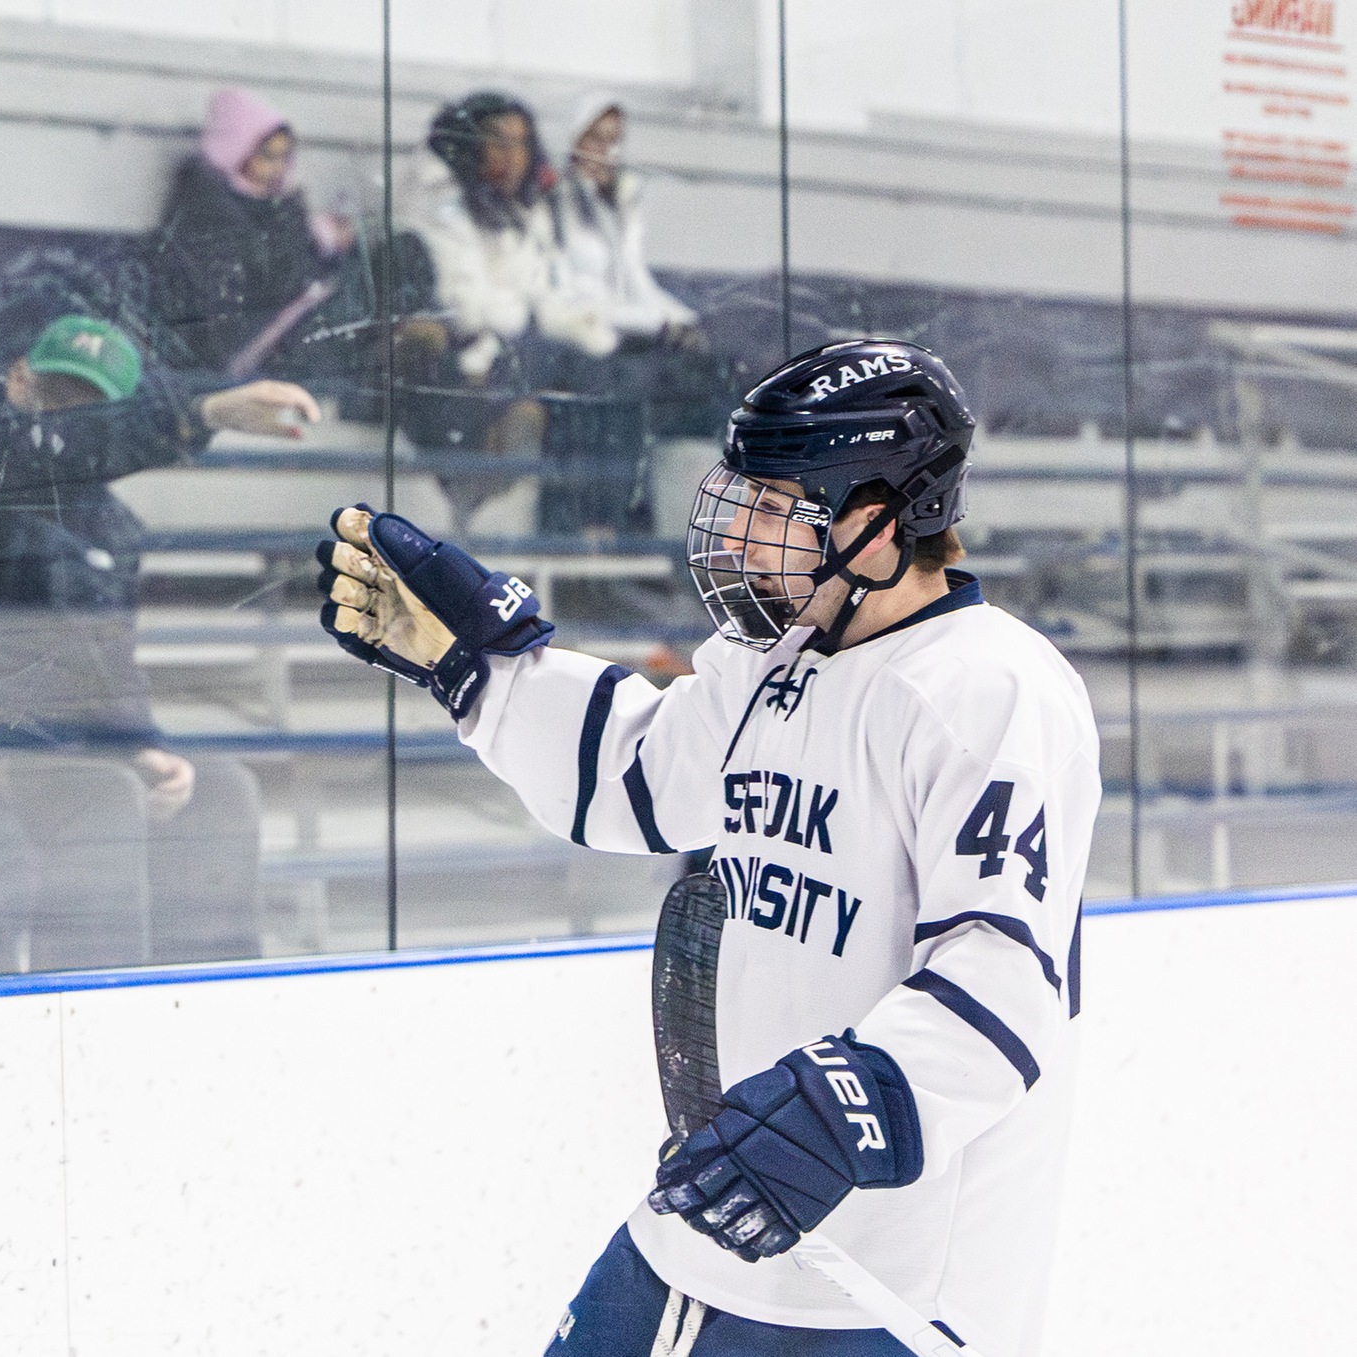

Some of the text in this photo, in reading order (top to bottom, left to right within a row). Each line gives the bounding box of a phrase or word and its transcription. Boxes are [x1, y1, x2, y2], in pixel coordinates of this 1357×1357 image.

[809, 353, 913, 400] RAMS
[792, 513, 829, 527] CCM
[955, 780, 1049, 903] 44
[802, 1041, 887, 1152] UER
